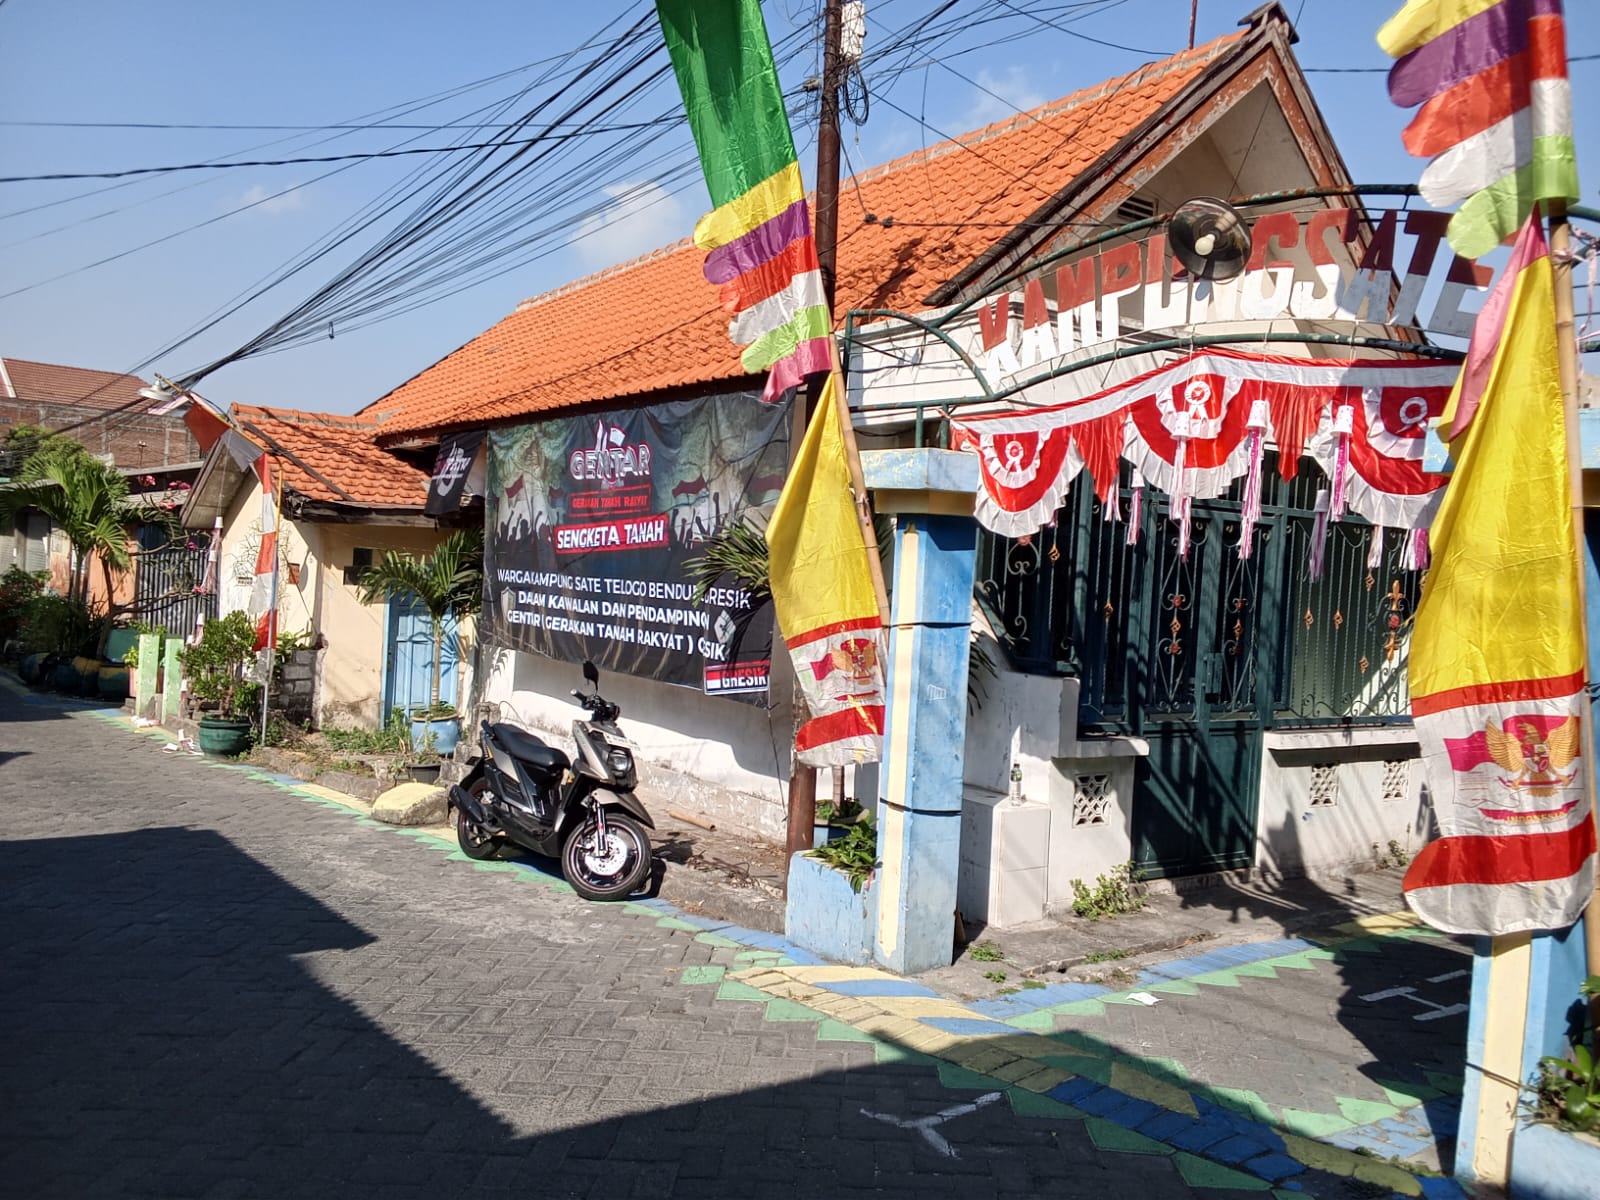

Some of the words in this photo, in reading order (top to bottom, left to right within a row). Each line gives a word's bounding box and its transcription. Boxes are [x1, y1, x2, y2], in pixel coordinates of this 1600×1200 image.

[570, 444, 651, 481] GENTAR
[556, 526, 620, 549] SENGKETA
[623, 520, 665, 544] TANAH
[497, 568, 530, 584] WARGA
[575, 575, 601, 593] SATE
[604, 579, 646, 597] TELOGO
[548, 594, 599, 615] KAWALAN
[602, 601, 626, 618] DAN
[597, 623, 635, 643] TANAH
[637, 629, 684, 651] RAKYAT
[721, 667, 767, 689] GRESIK
